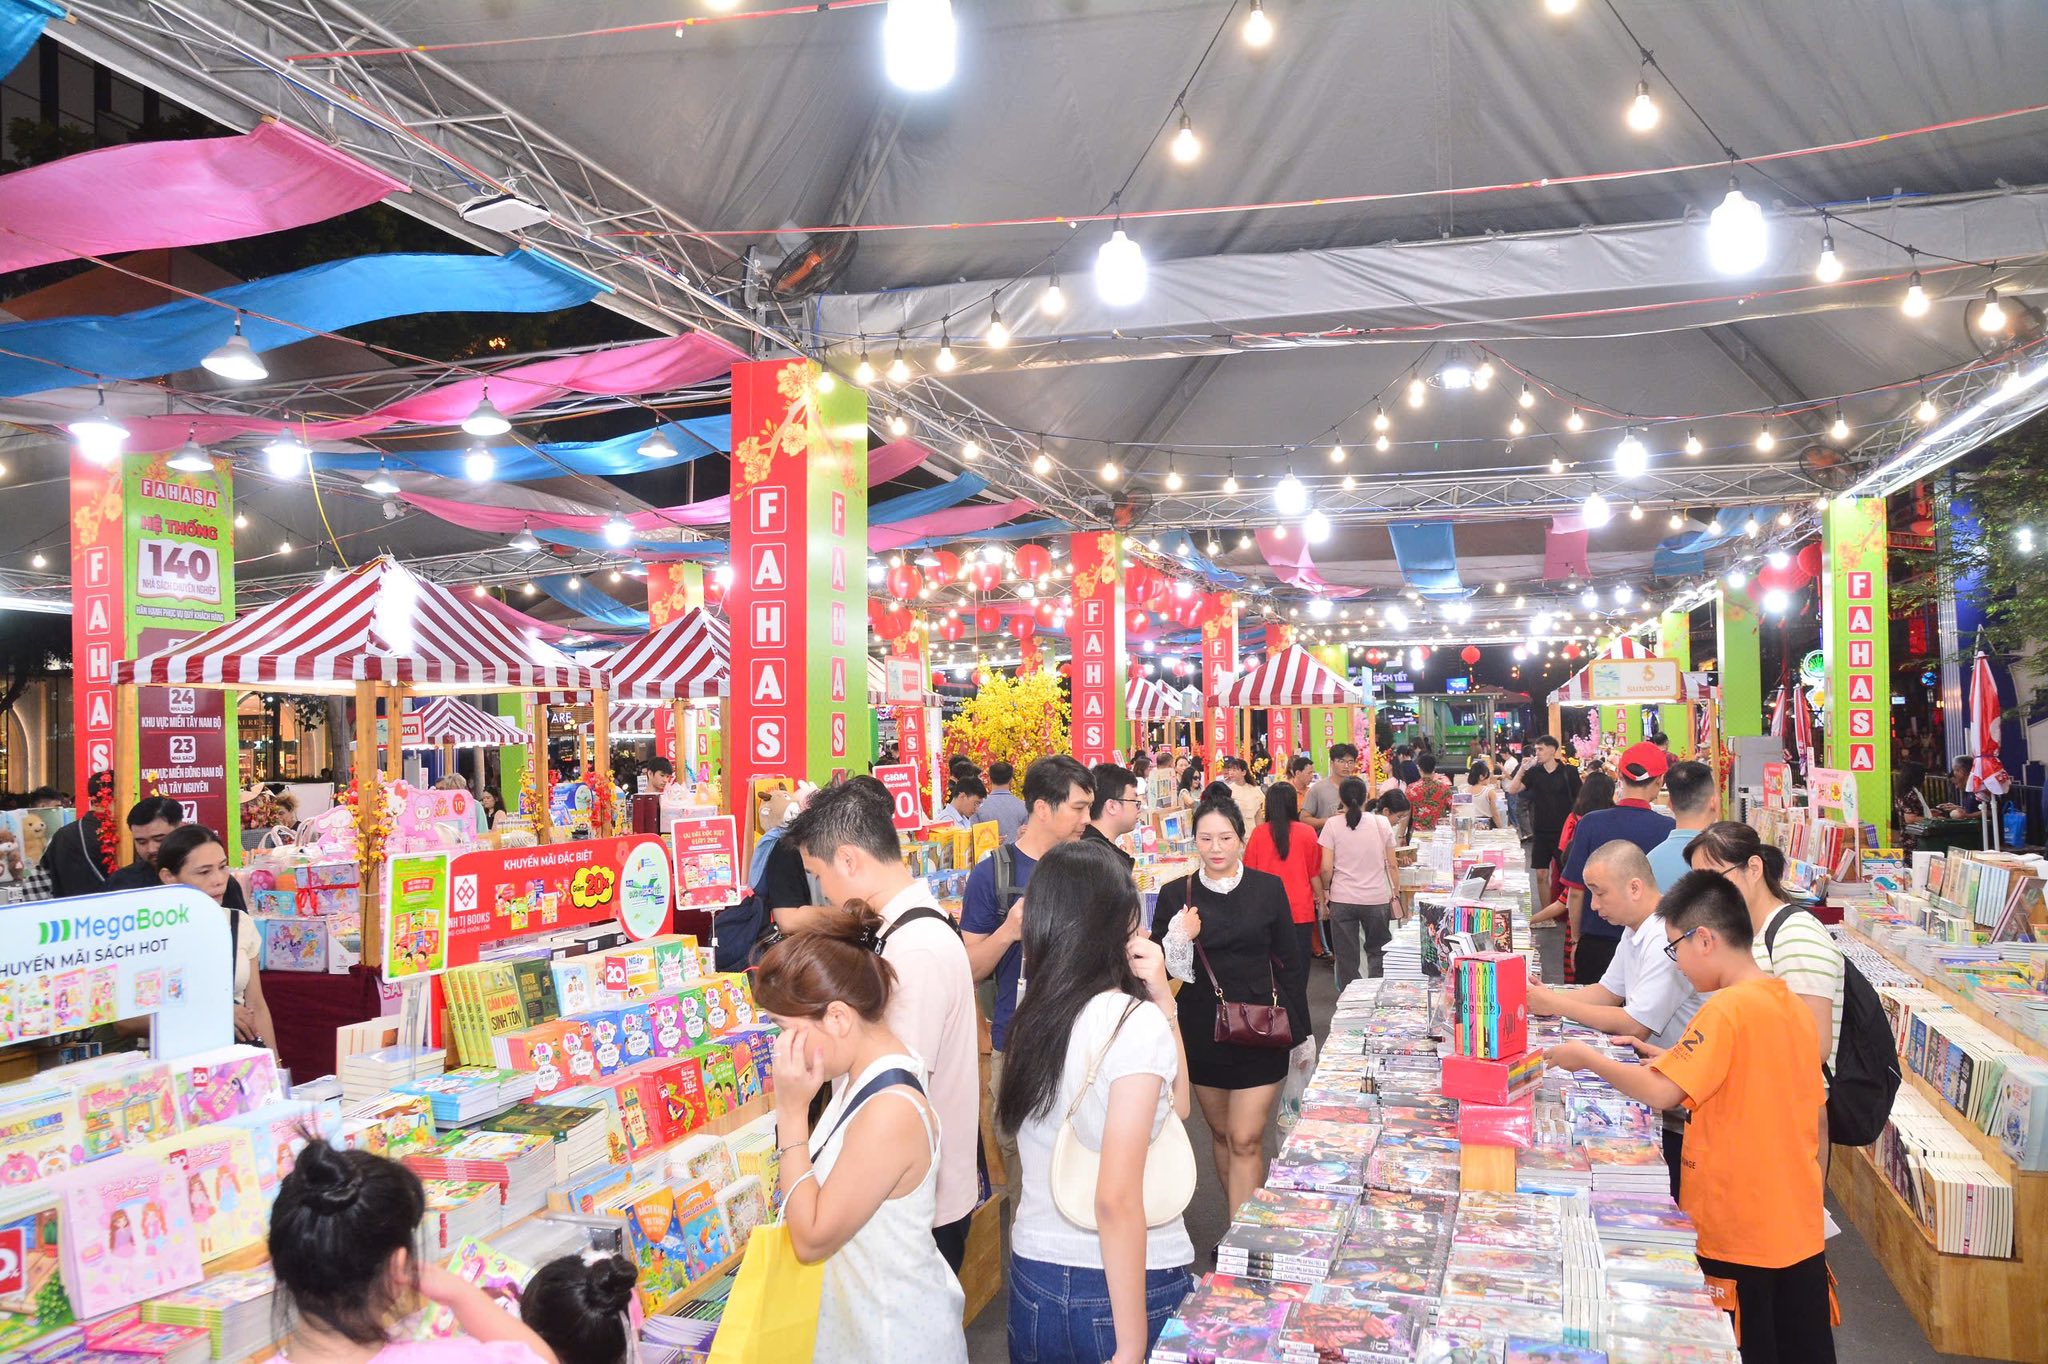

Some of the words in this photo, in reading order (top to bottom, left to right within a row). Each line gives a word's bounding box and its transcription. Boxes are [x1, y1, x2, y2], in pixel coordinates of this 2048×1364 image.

[143, 480, 217, 507] FAHASA
[141, 514, 163, 535] HỆ
[165, 519, 218, 541] THỐNG
[148, 543, 211, 582] 140
[143, 578, 156, 589] NHÀ
[157, 580, 172, 591] SÁCH
[173, 582, 195, 593] CHUYÊN
[197, 584, 217, 595] NGHIỆP
[755, 491, 782, 759] FAHAS
[833, 494, 845, 753] FAHAS
[1849, 575, 1874, 769] FAHASA
[171, 689, 194, 705] 24
[142, 717, 156, 728] KHU
[156, 716, 169, 729] VỰC
[186, 715, 199, 728] TÂY
[199, 717, 213, 727] NAM
[213, 716, 221, 730] BỘ
[172, 738, 193, 754] 23
[201, 767, 215, 778] NAM
[215, 765, 223, 779] BỘ
[883, 771, 908, 781] GIẢM
[169, 781, 182, 793] TÂY
[182, 780, 209, 793] NGUYÊN
[504, 854, 539, 871] KHUYẾN
[540, 852, 557, 866] MÃI
[557, 851, 575, 866] ĐẶC
[575, 849, 593, 863] BIỆT
[585, 872, 610, 897] 20%
[75, 904, 190, 940] MegaBook
[448, 917, 459, 928] NH
[466, 912, 490, 927] BOOKS
[61, 951, 90, 968] MÃI
[95, 942, 135, 962] SÁCH
[139, 938, 169, 954] HOT
[491, 1013, 507, 1031] SINH
[507, 1008, 522, 1027] TỒN
[193, 1073, 208, 1082] 20
[1707, 1284, 1726, 1299] ER
